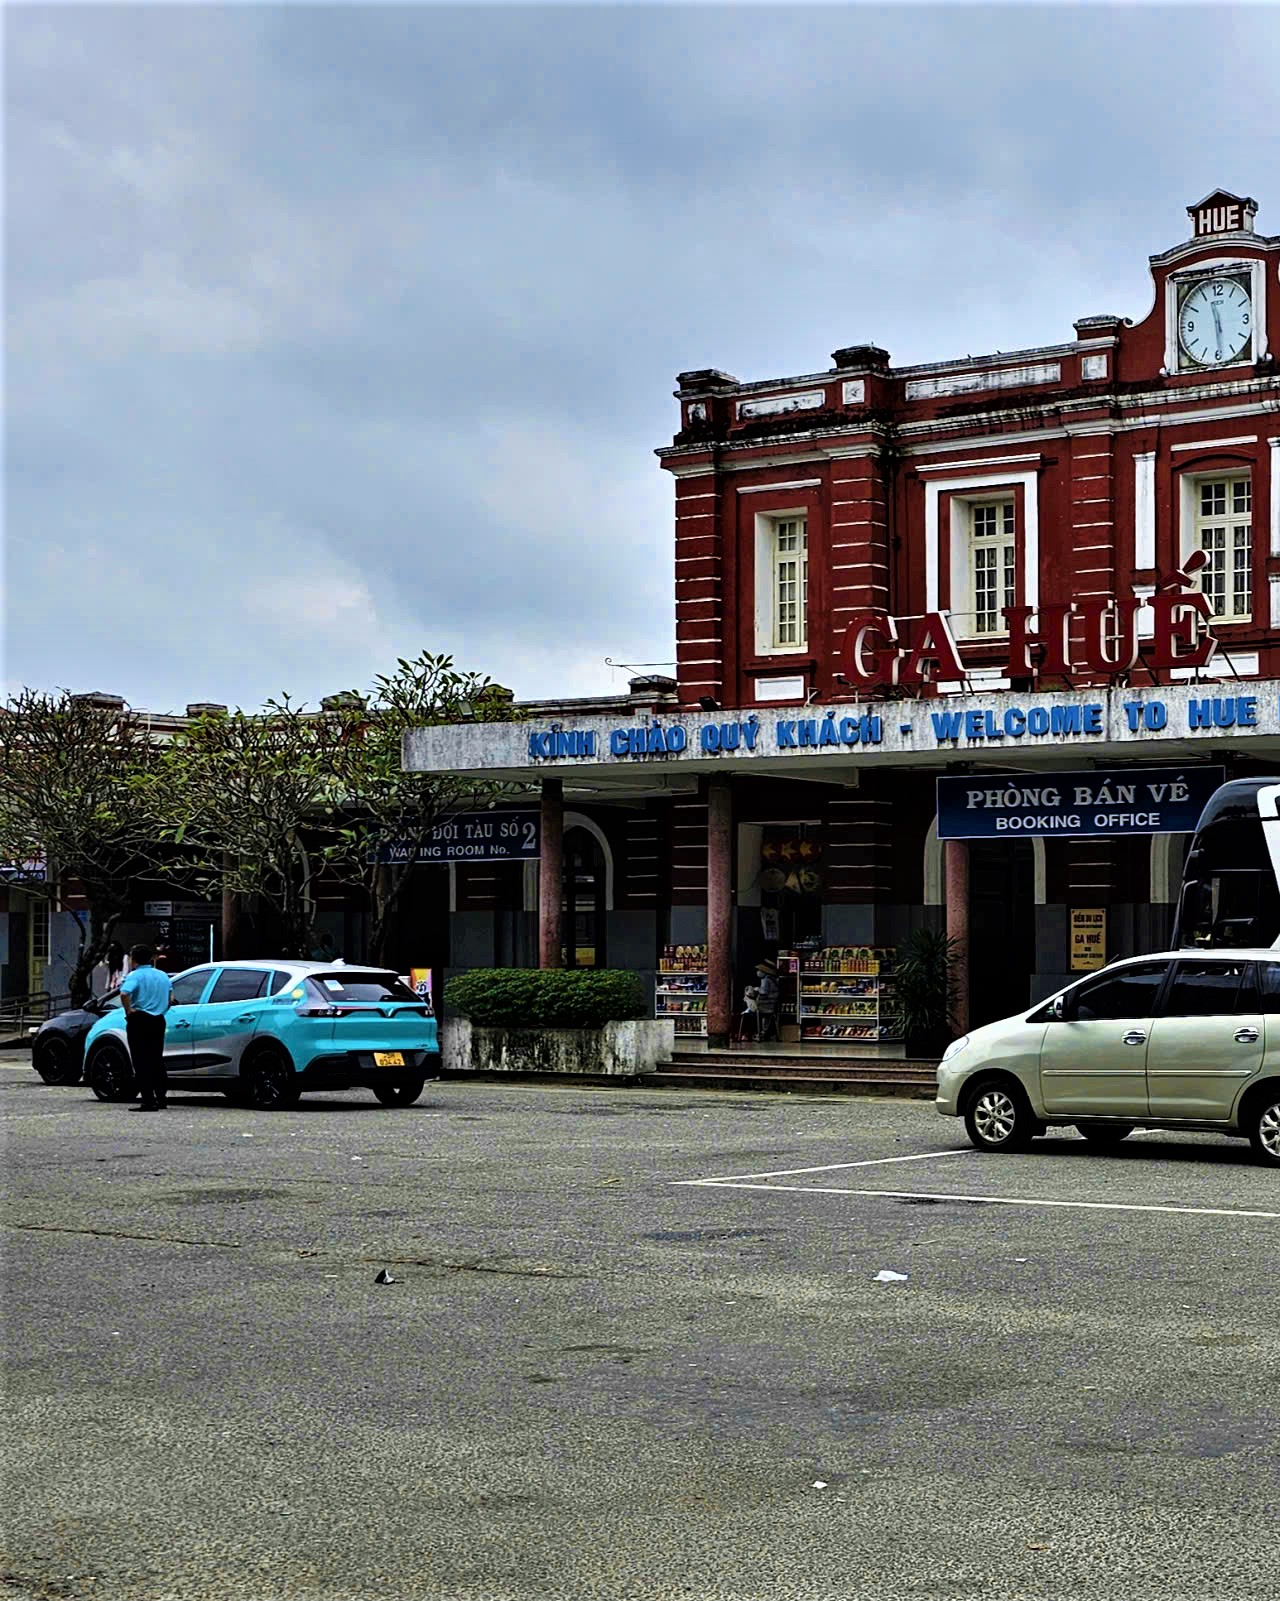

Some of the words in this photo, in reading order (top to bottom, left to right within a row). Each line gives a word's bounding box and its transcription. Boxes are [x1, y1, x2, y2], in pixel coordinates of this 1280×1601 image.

[1199, 204, 1239, 234] HUE
[1212, 283, 1224, 297] 12
[1187, 321, 1195, 332] 9
[1242, 313, 1250, 325] 3
[839, 611, 970, 687] GA
[1001, 550, 1218, 679] HUẾ
[610, 719, 687, 755] CHÀO
[700, 714, 759, 754] QUÝ
[776, 711, 883, 749] KHÁCH
[931, 704, 1103, 740] WELCOME
[1125, 701, 1167, 731] TO
[1189, 696, 1257, 729] HUE
[966, 782, 1062, 809] PHÒNG
[1073, 778, 1136, 806] BÁN
[1147, 775, 1190, 803] VÉ
[464, 819, 493, 839] TÀU
[500, 816, 519, 838] SỐ
[521, 822, 537, 849] 2
[996, 815, 1081, 830] BOOKING
[1094, 812, 1160, 828] OFFICE
[446, 845, 485, 857] ROOM
[490, 844, 510, 855] No.
